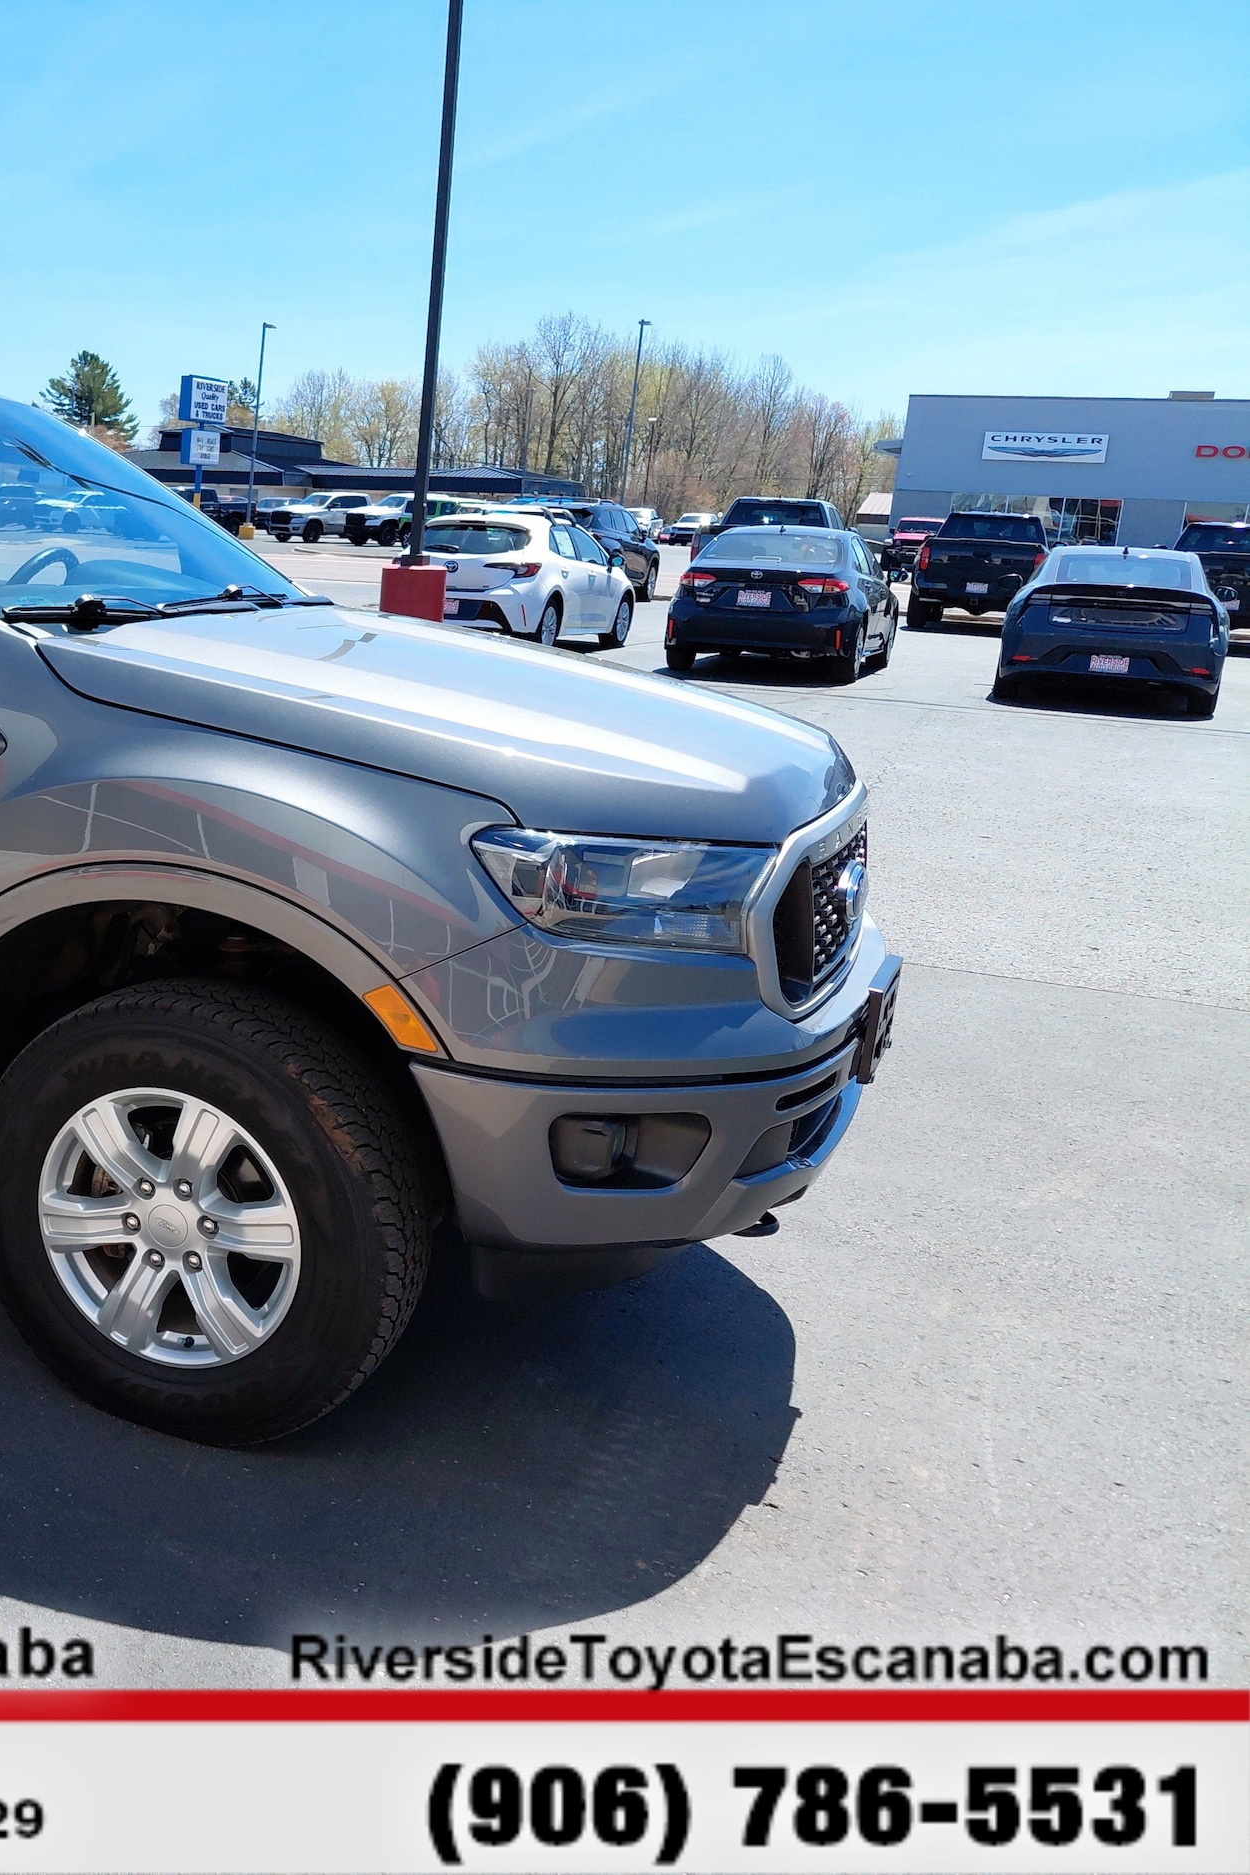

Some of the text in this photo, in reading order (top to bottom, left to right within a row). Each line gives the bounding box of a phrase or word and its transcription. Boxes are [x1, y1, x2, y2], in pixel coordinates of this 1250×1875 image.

[196, 382, 226, 393] RIVERSIDE
[201, 392, 219, 402] Quality
[194, 401, 225, 412] USED CARS
[202, 411, 223, 420] TRUCKS
[990, 434, 1103, 444] CHRYSLER
[1195, 444, 1250, 459] DO
[1091, 656, 1129, 666] RIVERSIDE
